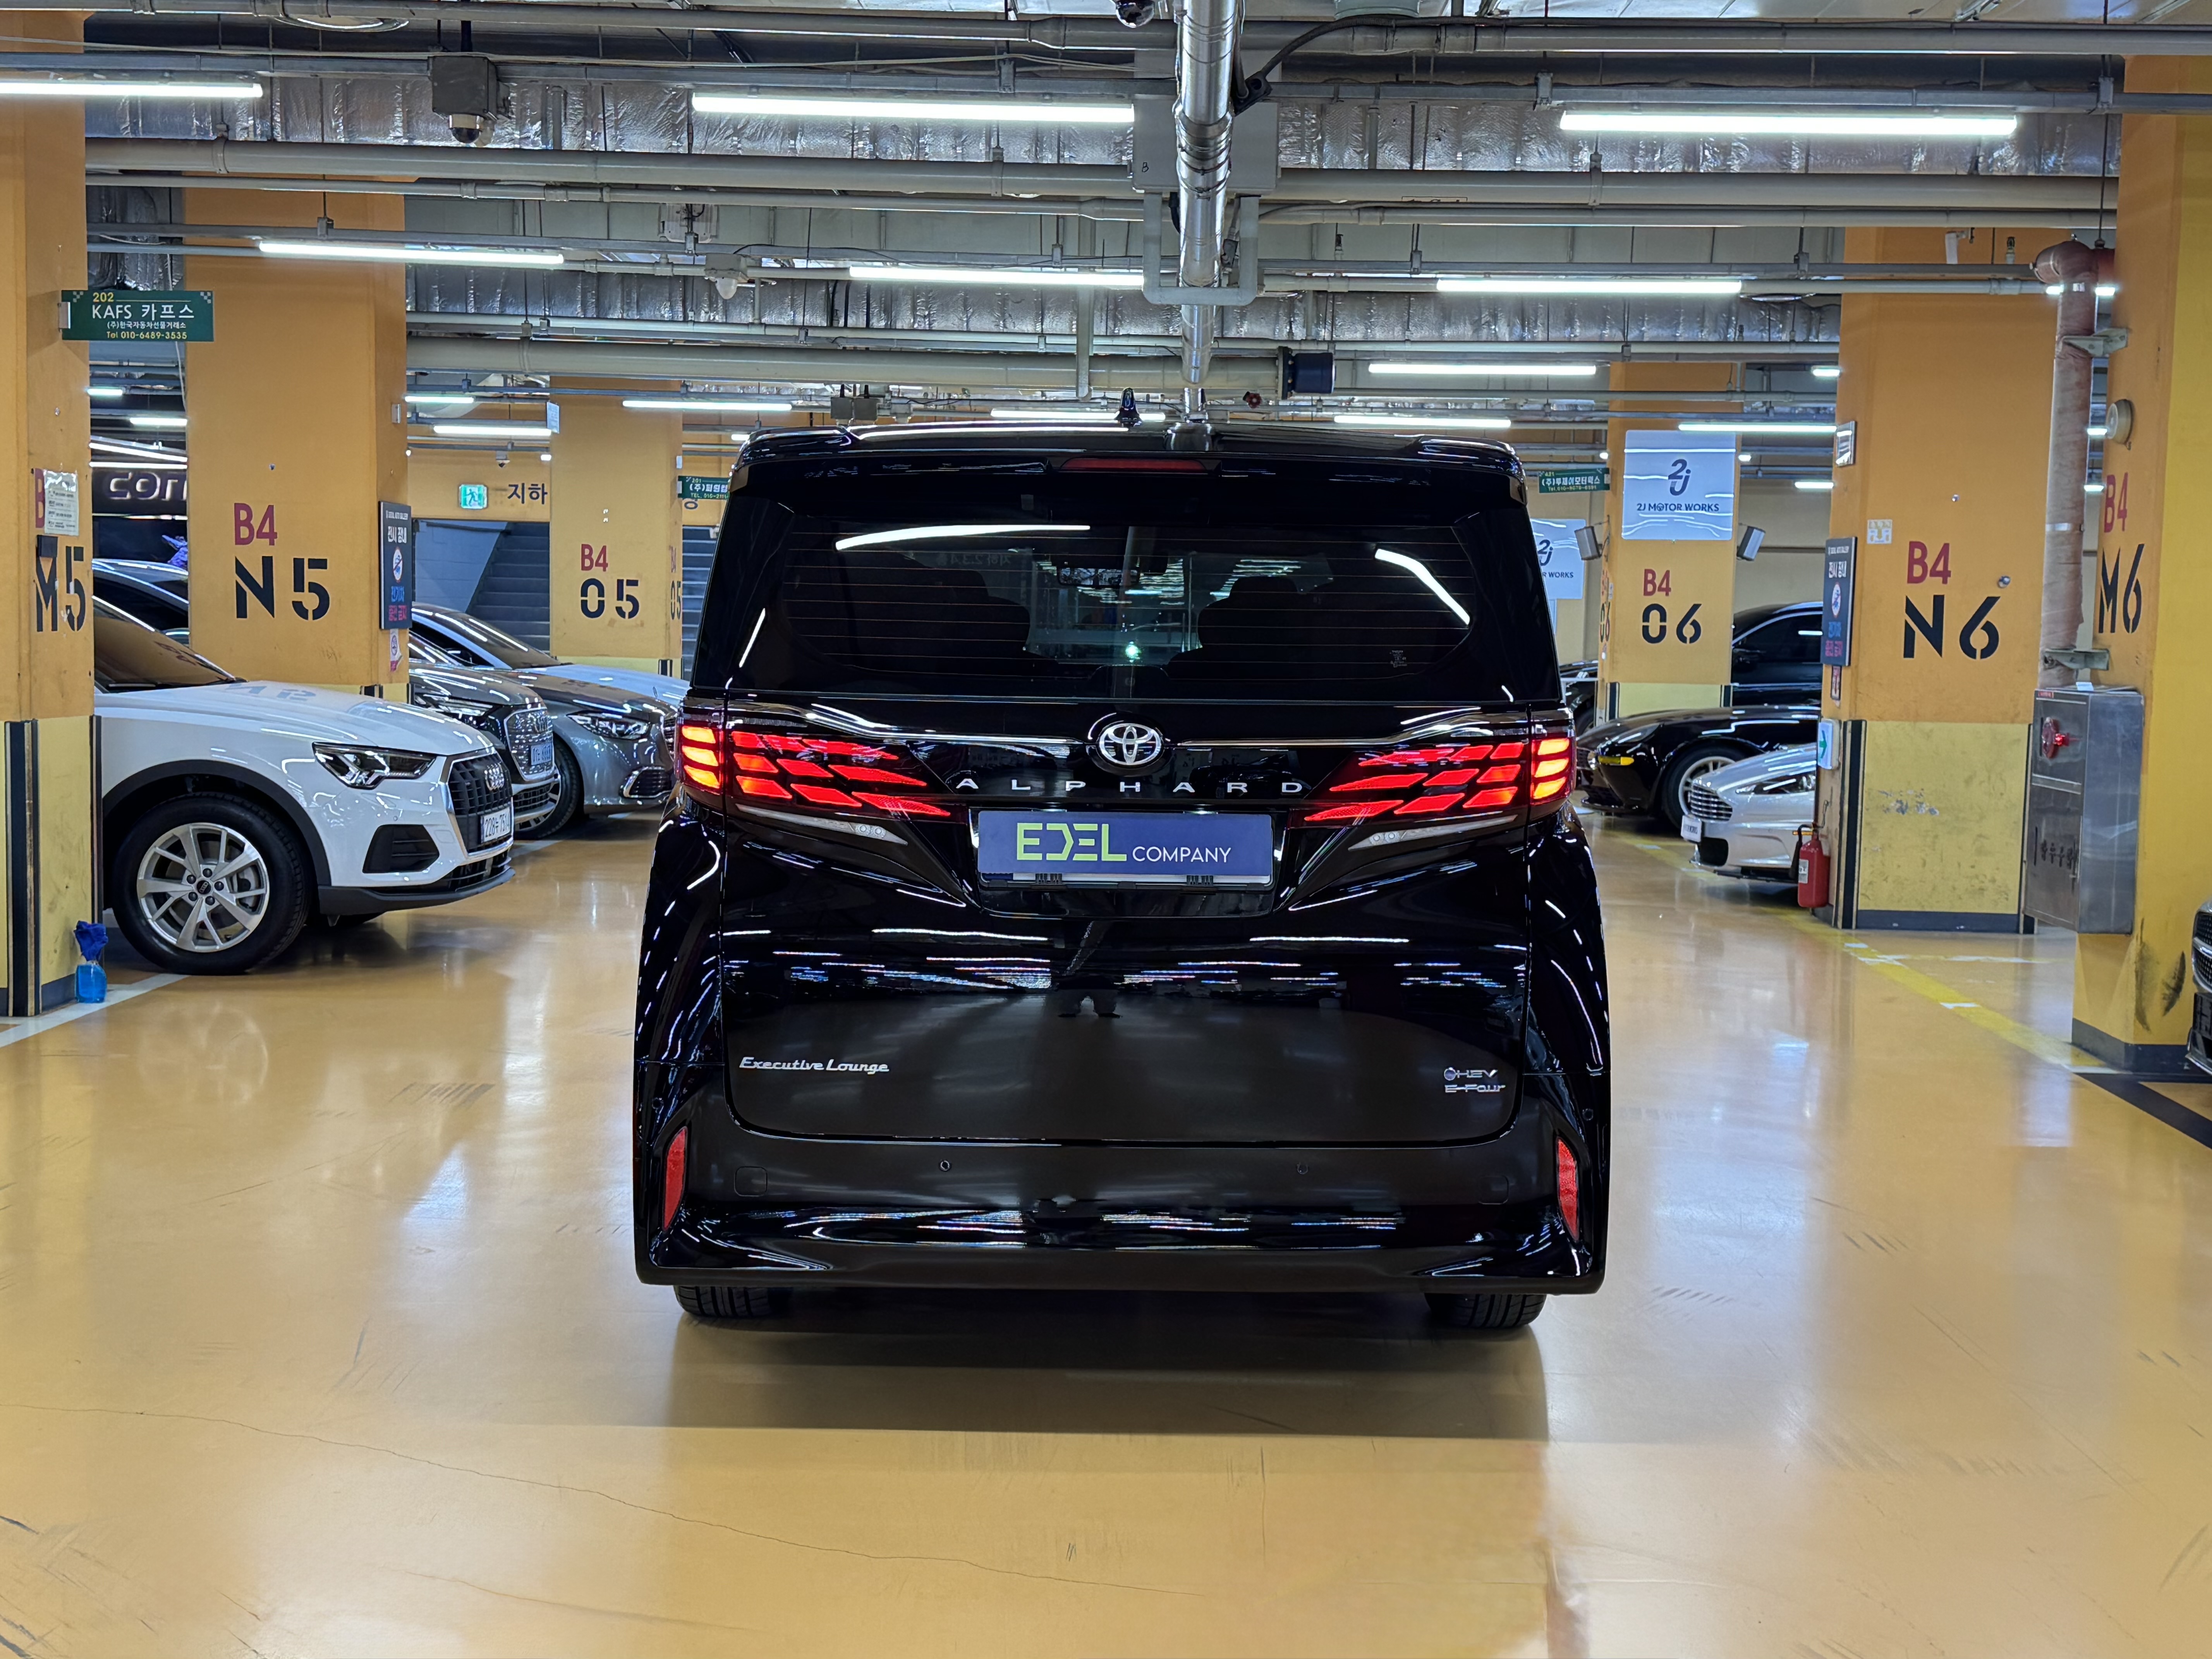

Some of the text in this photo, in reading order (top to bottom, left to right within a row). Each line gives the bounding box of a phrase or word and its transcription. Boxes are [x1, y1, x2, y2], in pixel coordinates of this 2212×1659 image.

[93, 292, 114, 303] 202
[92, 303, 194, 321] KAFS 카프스
[121, 331, 187, 340] 010-6489-3535
[508, 483, 548, 505] 지하
[2104, 472, 2128, 533] B4
[1685, 503, 1719, 512] WORKS
[234, 503, 278, 546] B4
[580, 544, 608, 572] B4
[1907, 541, 1951, 584] B4
[235, 556, 330, 620] N5
[1644, 569, 1671, 596] B4
[2098, 543, 2145, 634] M6
[1903, 594, 2000, 659] N6
[956, 778, 1302, 793] ALPHARD
[1017, 822, 1231, 863] EDEL COMPANY
[739, 1056, 890, 1075] Executive Lounge
[1456, 1069, 1498, 1078] HEV
[1444, 1084, 1506, 1093] E-Four
